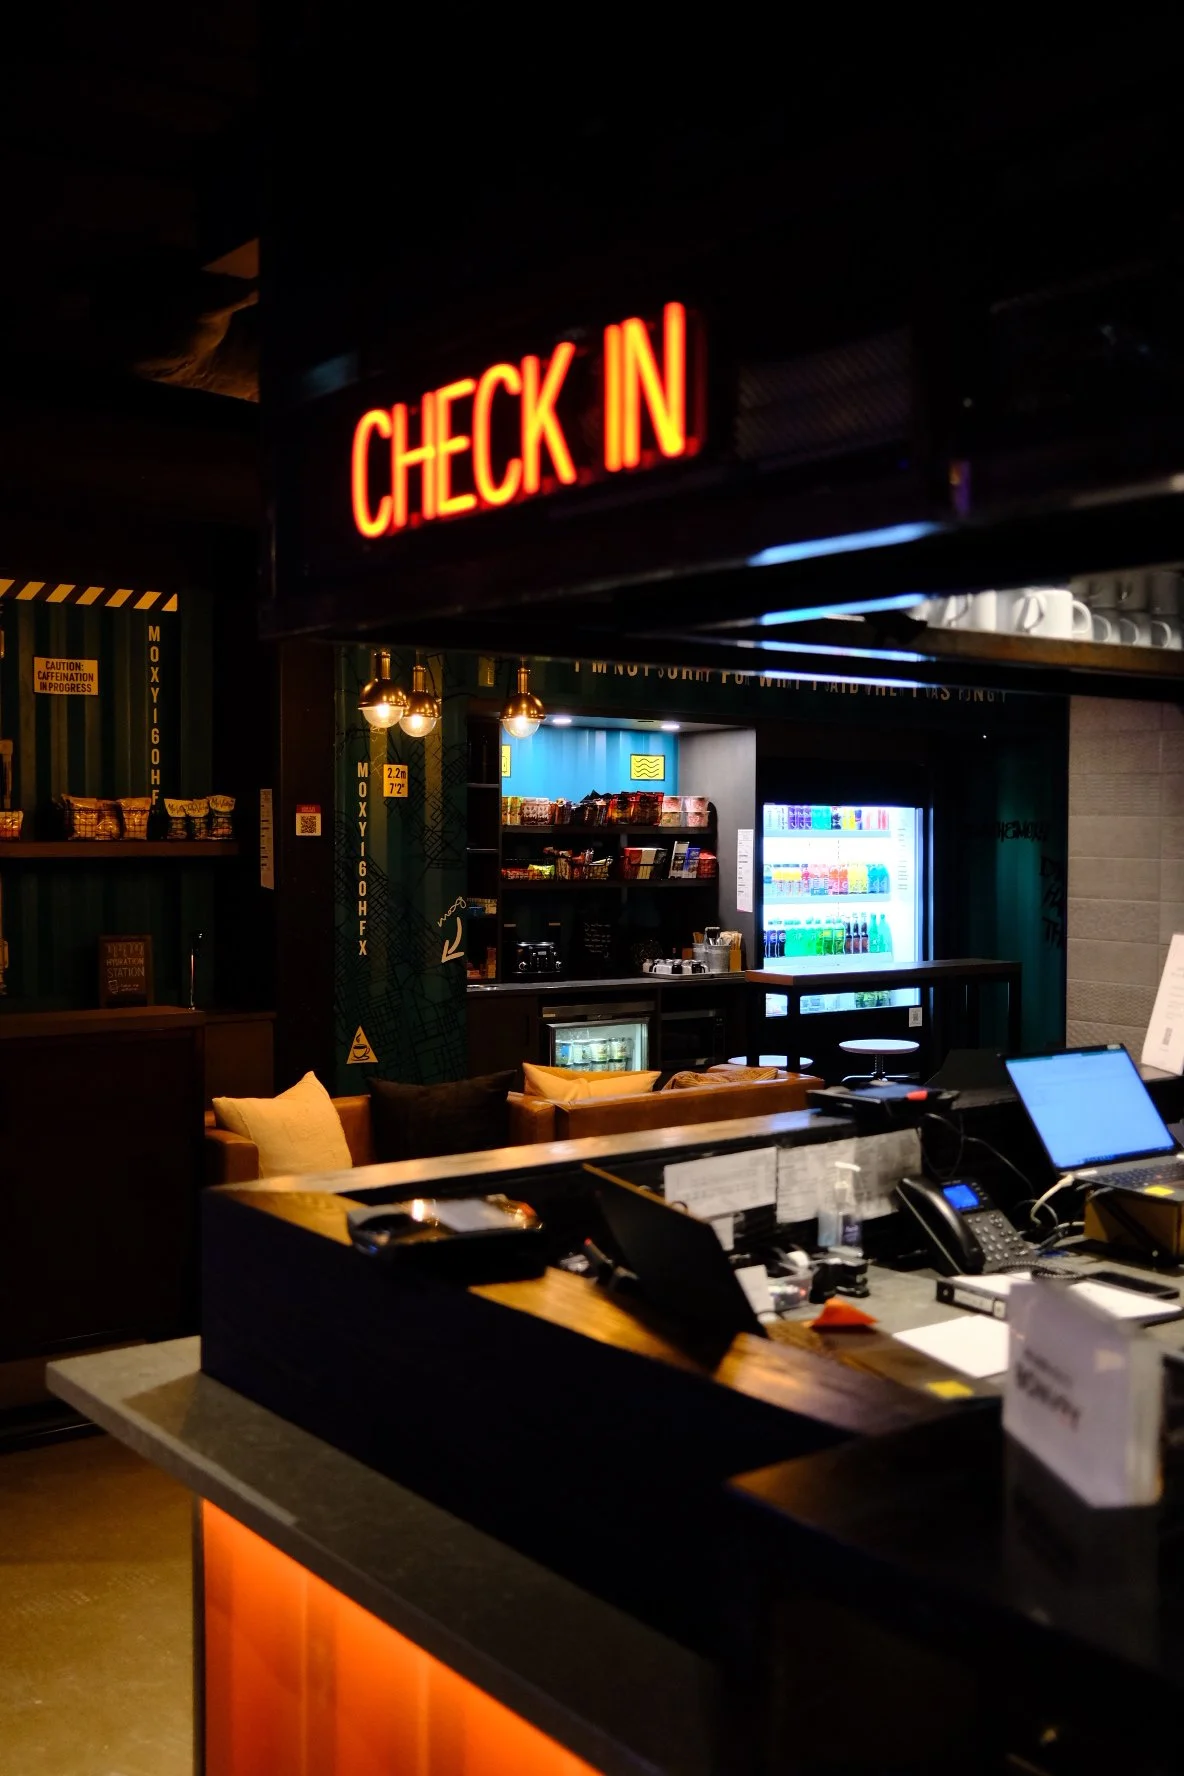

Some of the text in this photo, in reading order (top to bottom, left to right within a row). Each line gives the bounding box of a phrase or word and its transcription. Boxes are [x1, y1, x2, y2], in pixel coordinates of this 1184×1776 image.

[351, 300, 688, 539] CHECK IN
[45, 661, 84, 671] CAUTION:
[37, 670, 94, 682] CAFFEINATION
[40, 681, 92, 693] IN PROGRESS
[387, 767, 407, 780] 2.2m
